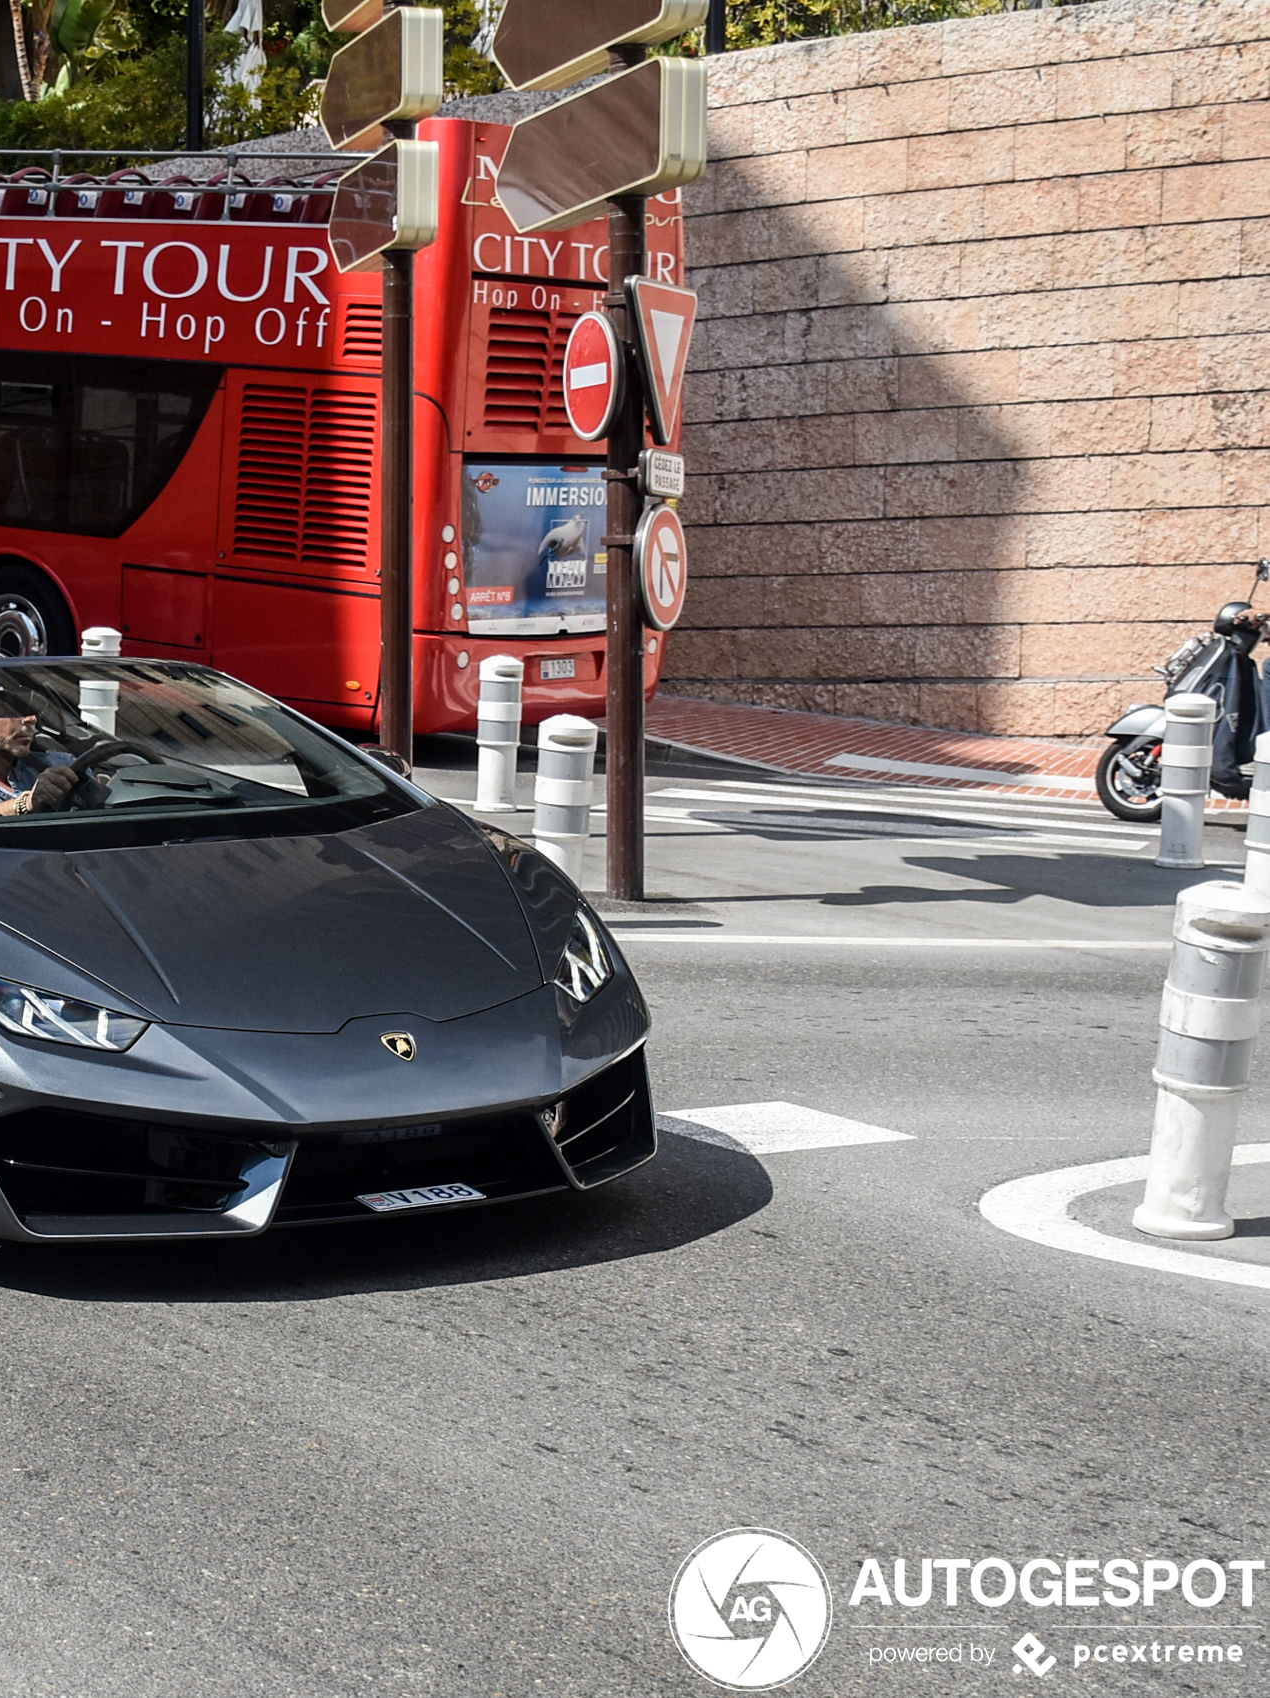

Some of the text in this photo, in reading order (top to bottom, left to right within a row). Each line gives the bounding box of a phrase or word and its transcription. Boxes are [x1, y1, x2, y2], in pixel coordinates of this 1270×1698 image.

[474, 233, 564, 277] CITY
[100, 240, 331, 305] TOUR
[473, 282, 518, 309] Hop
[531, 286, 560, 310] On
[19, 297, 73, 333] On
[140, 302, 225, 354] Hop
[255, 307, 331, 348] Off
[526, 486, 607, 507] IMMERSIO
[551, 660, 574, 675] 1303
[386, 1185, 474, 1204] V188
